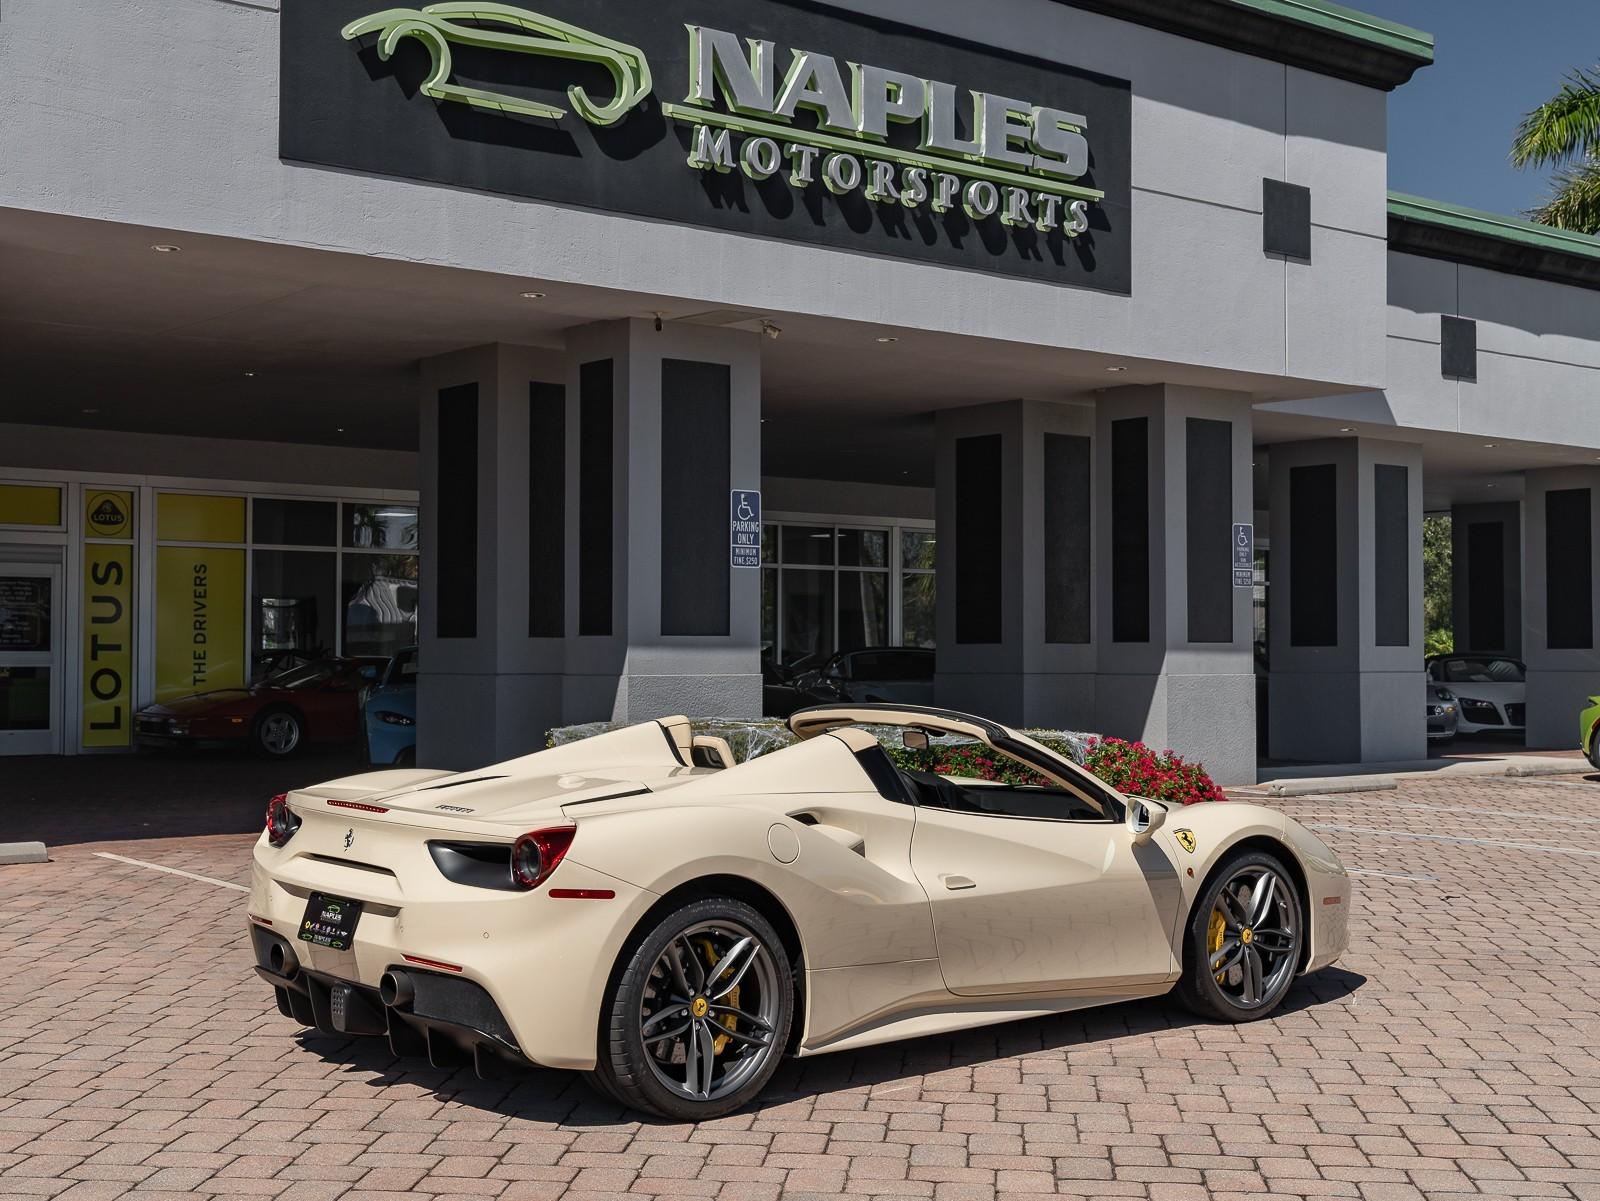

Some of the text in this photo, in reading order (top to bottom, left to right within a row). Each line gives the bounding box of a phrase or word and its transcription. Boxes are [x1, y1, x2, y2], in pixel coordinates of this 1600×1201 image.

[684, 23, 1089, 181] NAPLES
[687, 124, 1089, 238] MOTORSPORTS
[93, 514, 123, 523] LOTUS
[733, 520, 759, 533] PARKING
[737, 533, 754, 544] ONLY
[193, 563, 208, 644] DRIVERS
[90, 561, 123, 730] LOTUS
[193, 650, 207, 686] THE
[321, 910, 343, 921] NAPLES
